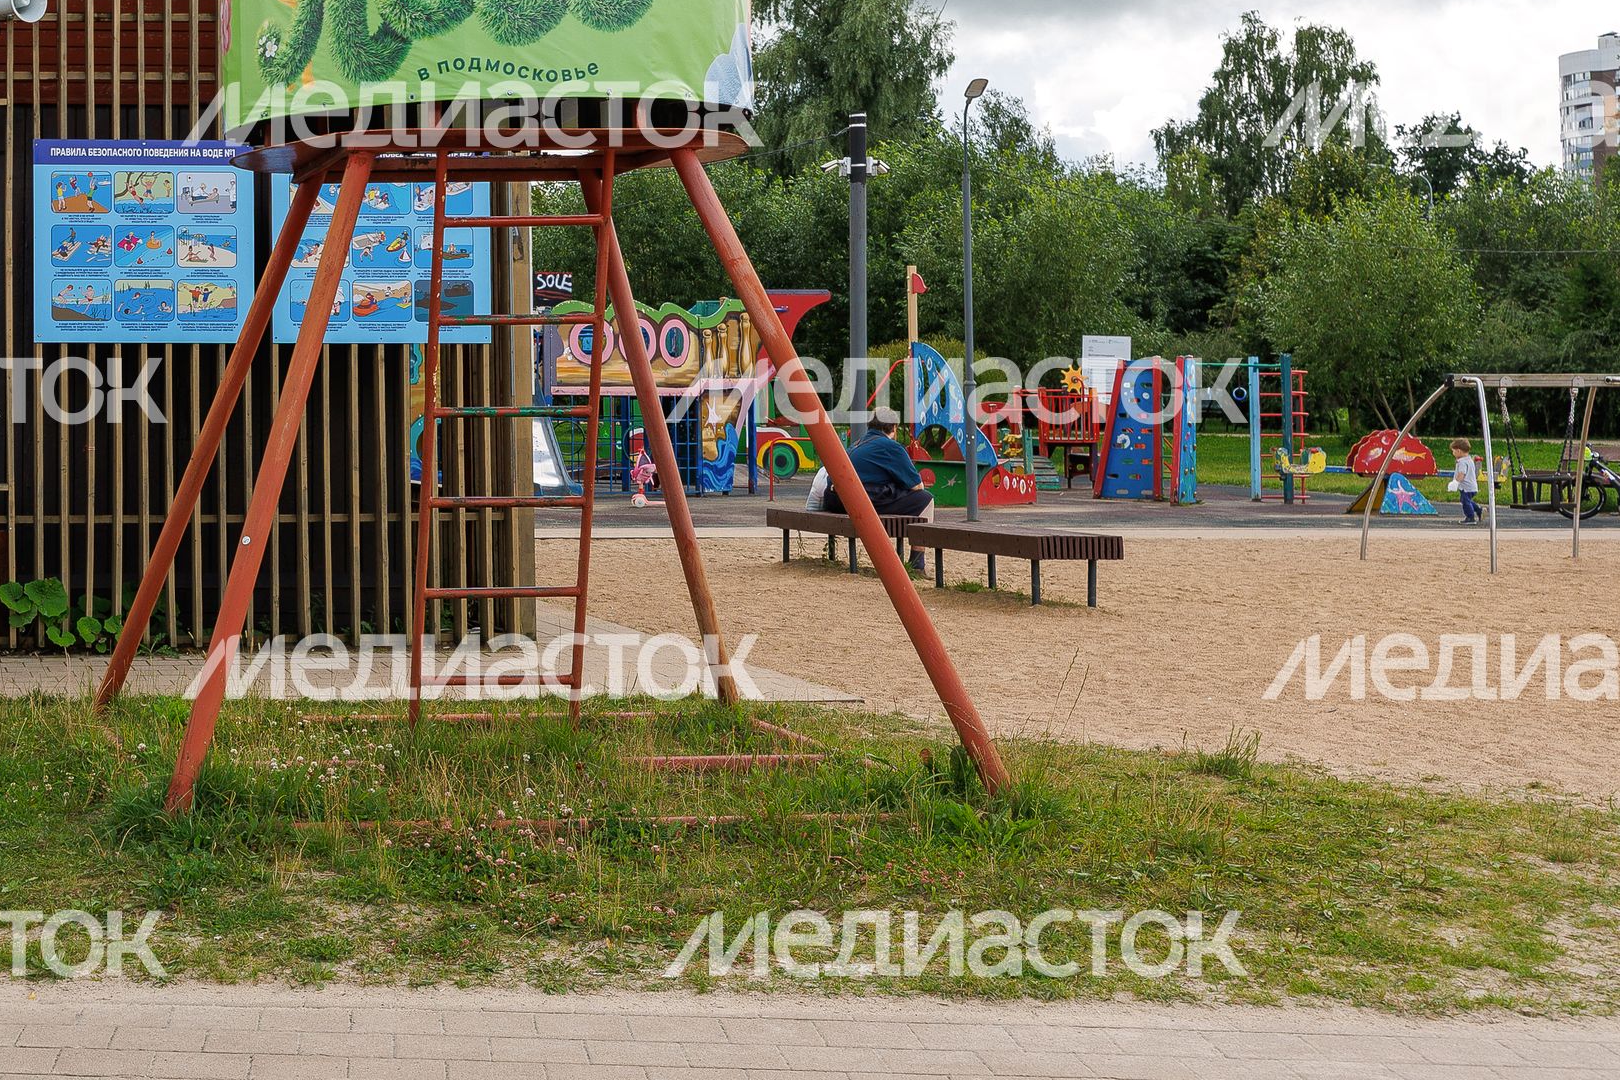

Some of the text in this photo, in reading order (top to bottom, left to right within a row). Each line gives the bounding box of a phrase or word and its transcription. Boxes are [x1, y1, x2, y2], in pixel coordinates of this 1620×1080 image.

[50, 147, 87, 157] ПРАВИЛА
[88, 147, 142, 157] БЕЗОПАСНОГО
[143, 148, 189, 158] ПОВЕДЕНИЯ
[190, 148, 201, 157] НА
[202, 148, 223, 159] ВОДЕ
